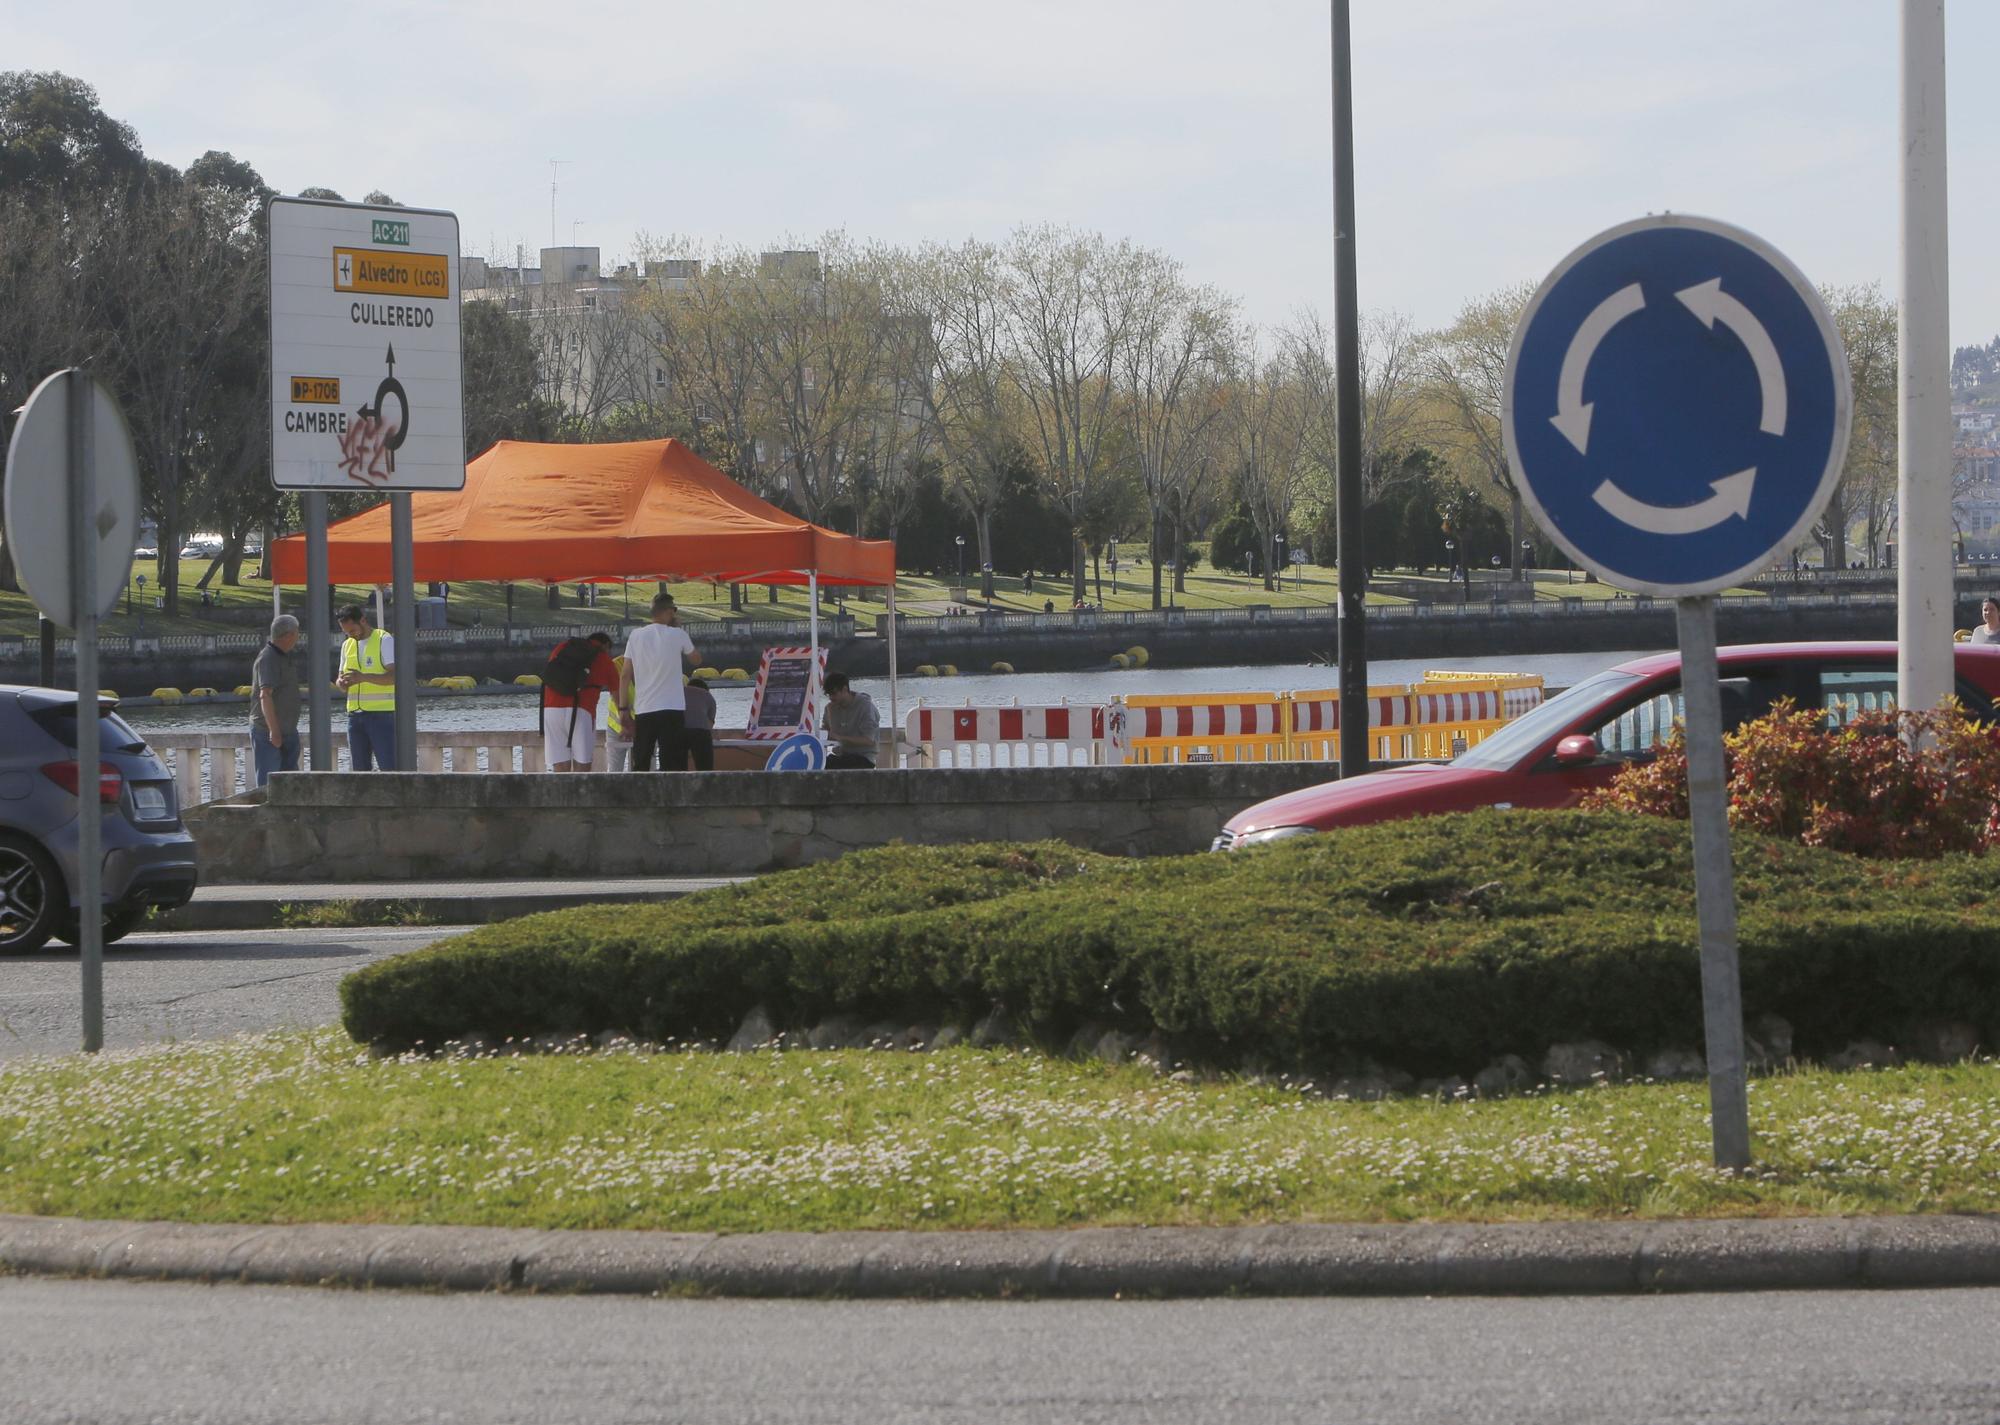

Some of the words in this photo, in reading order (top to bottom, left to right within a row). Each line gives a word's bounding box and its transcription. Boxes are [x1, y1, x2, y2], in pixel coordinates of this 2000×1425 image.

[374, 223, 408, 243] AC-211
[358, 260, 409, 284] Alvedro
[414, 268, 446, 289] (LCG)
[350, 302, 434, 328] CULLEREDO
[284, 411, 347, 433] CAMBRE
